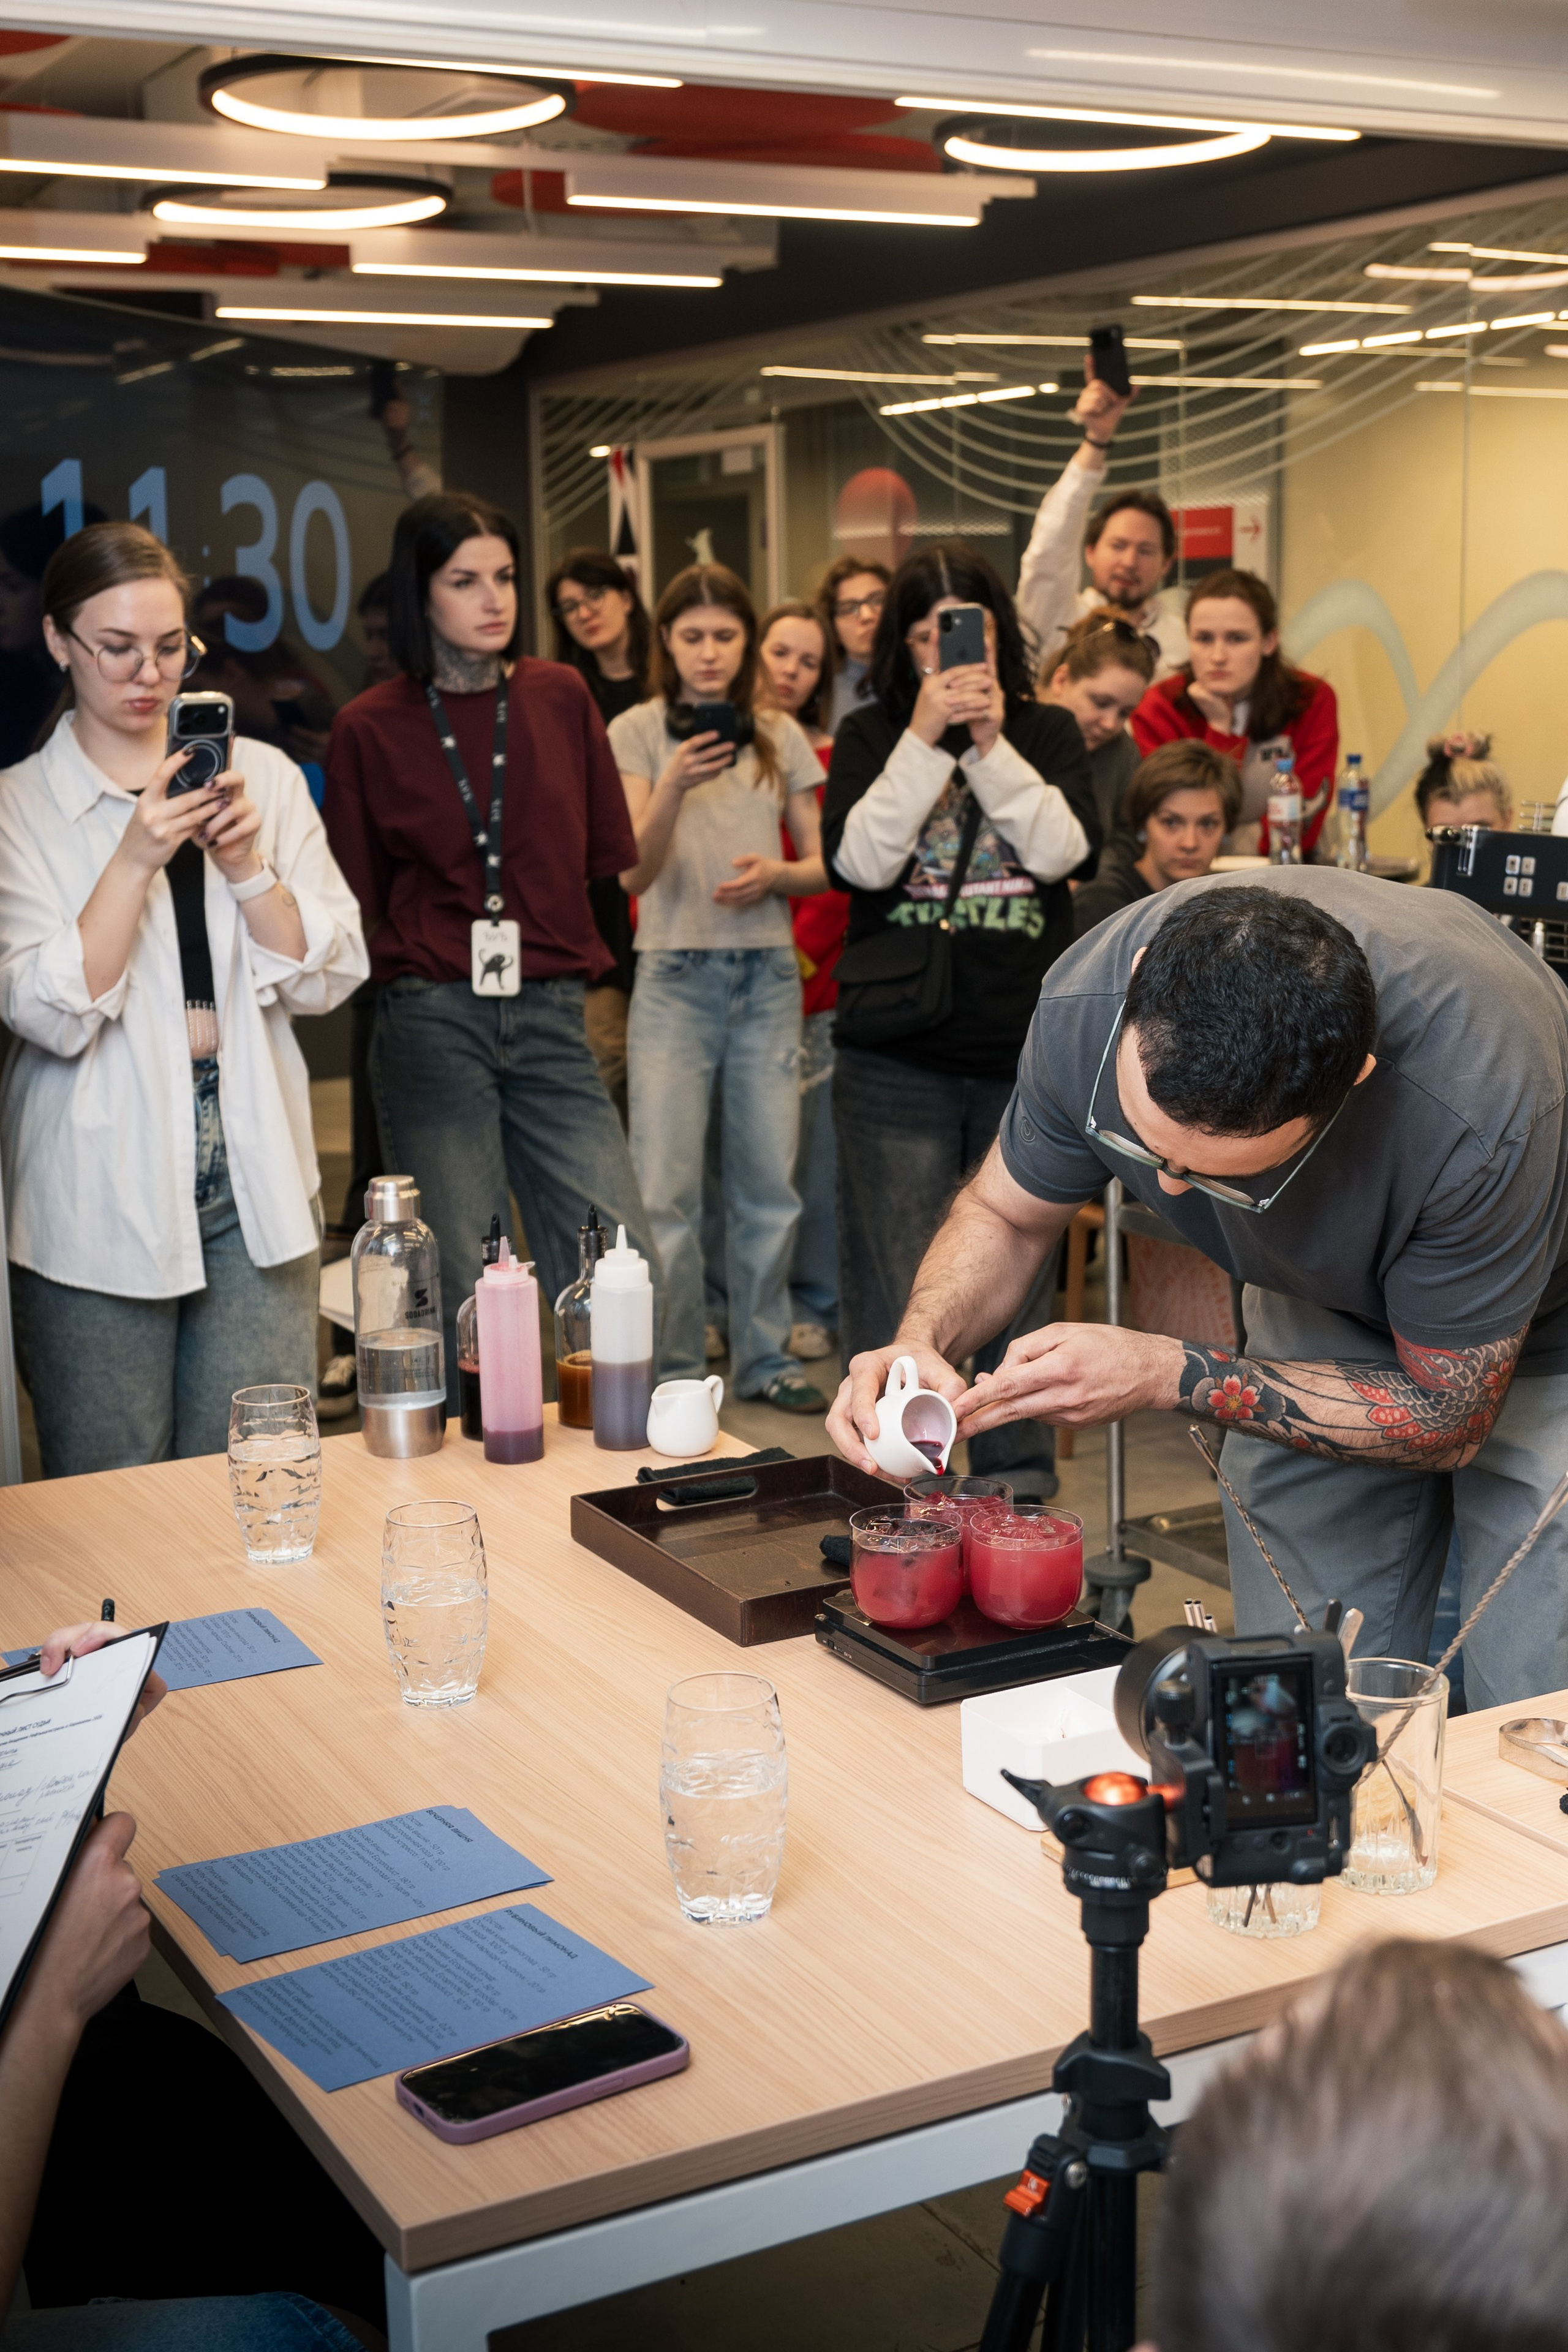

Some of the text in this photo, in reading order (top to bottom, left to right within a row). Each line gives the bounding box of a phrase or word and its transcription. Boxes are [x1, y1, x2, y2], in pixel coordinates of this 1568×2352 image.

[405, 1306, 435, 1319] SODADRINK
[425, 1809, 474, 1842] ВЕЧЕРНЯЯ ВИШНЯ
